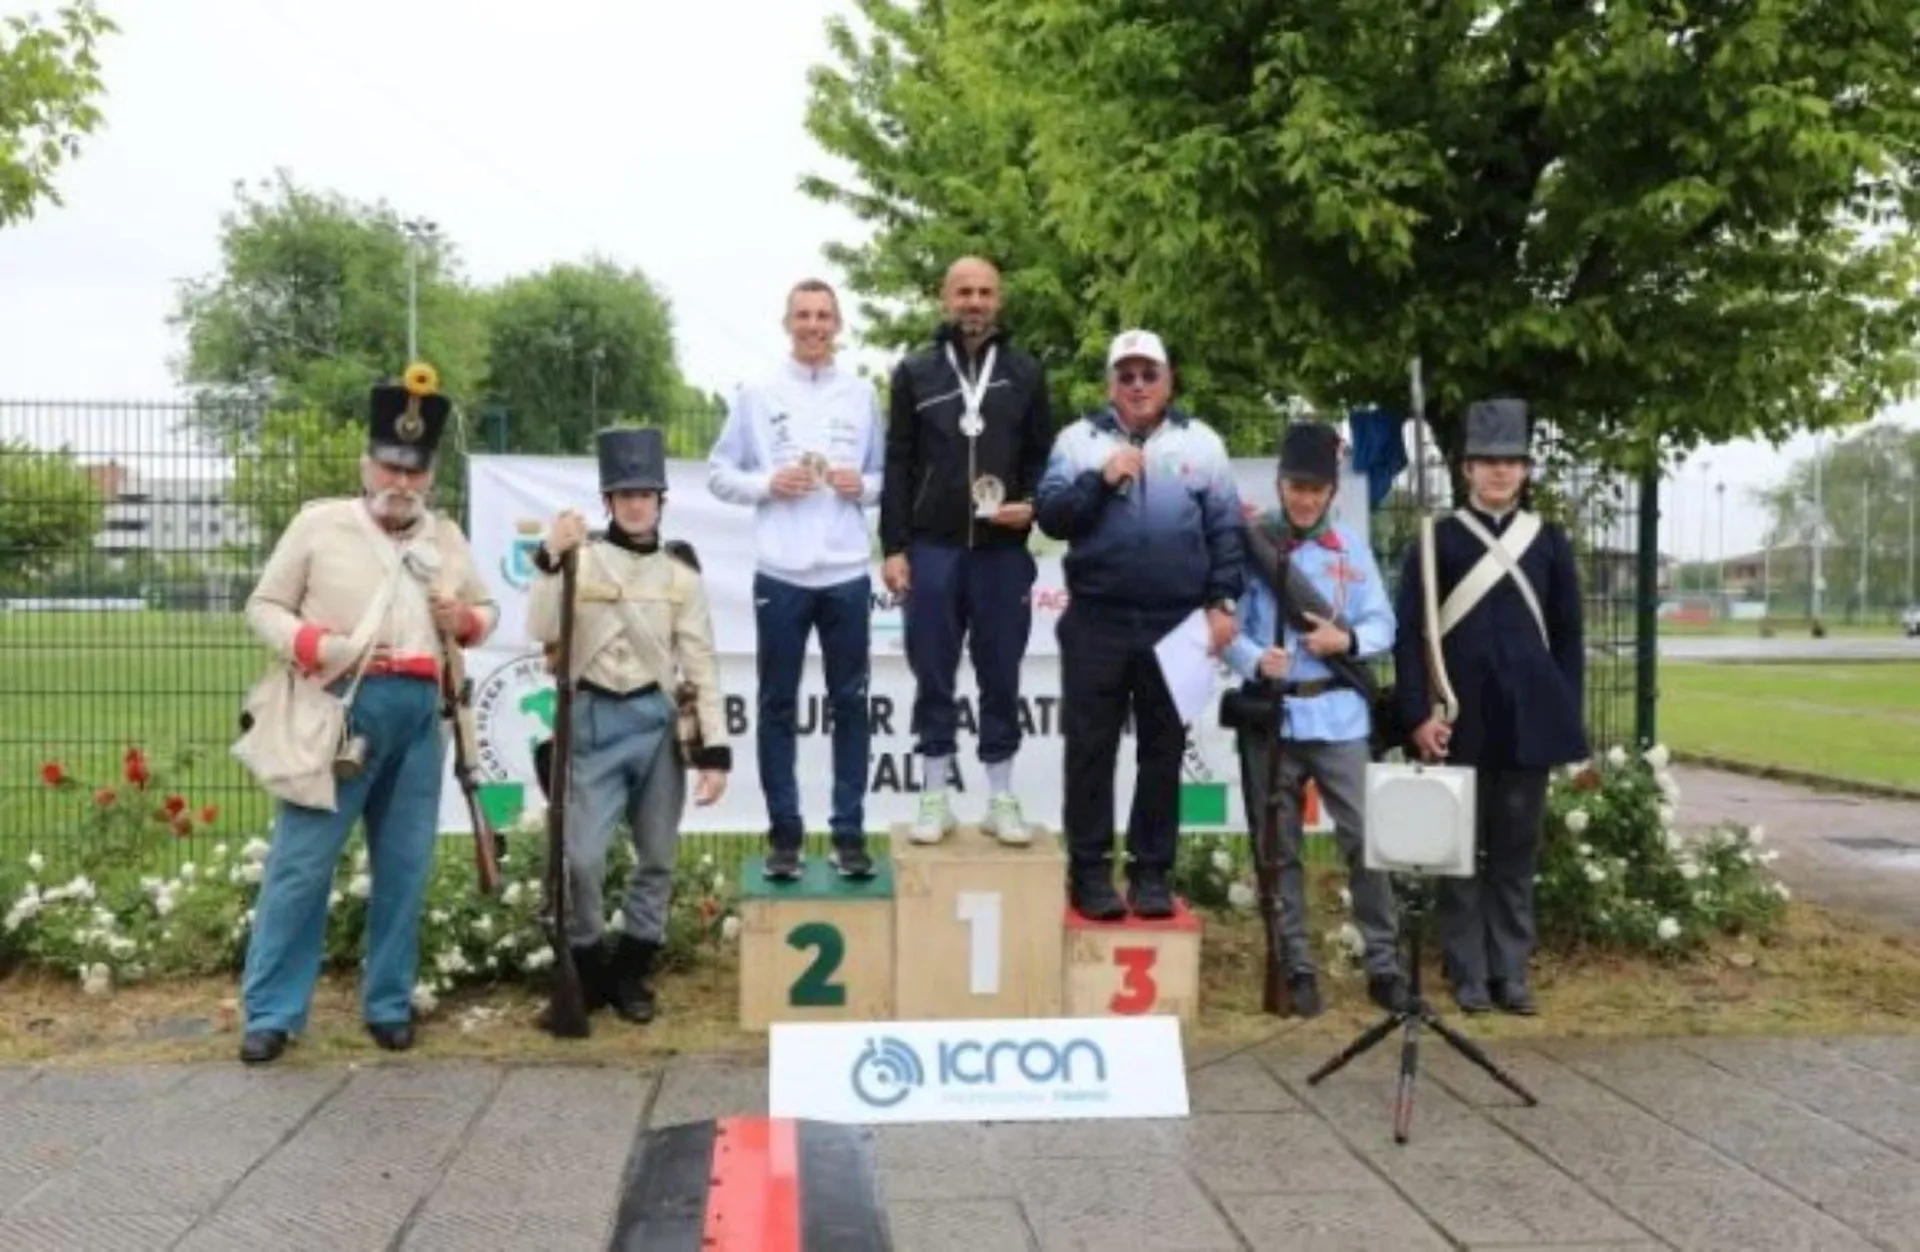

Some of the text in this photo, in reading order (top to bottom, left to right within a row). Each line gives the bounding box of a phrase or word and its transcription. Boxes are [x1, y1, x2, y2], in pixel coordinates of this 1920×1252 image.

[785, 921, 847, 1008] 2
[956, 891, 1002, 995] 1
[1108, 946, 1158, 1016] 3
